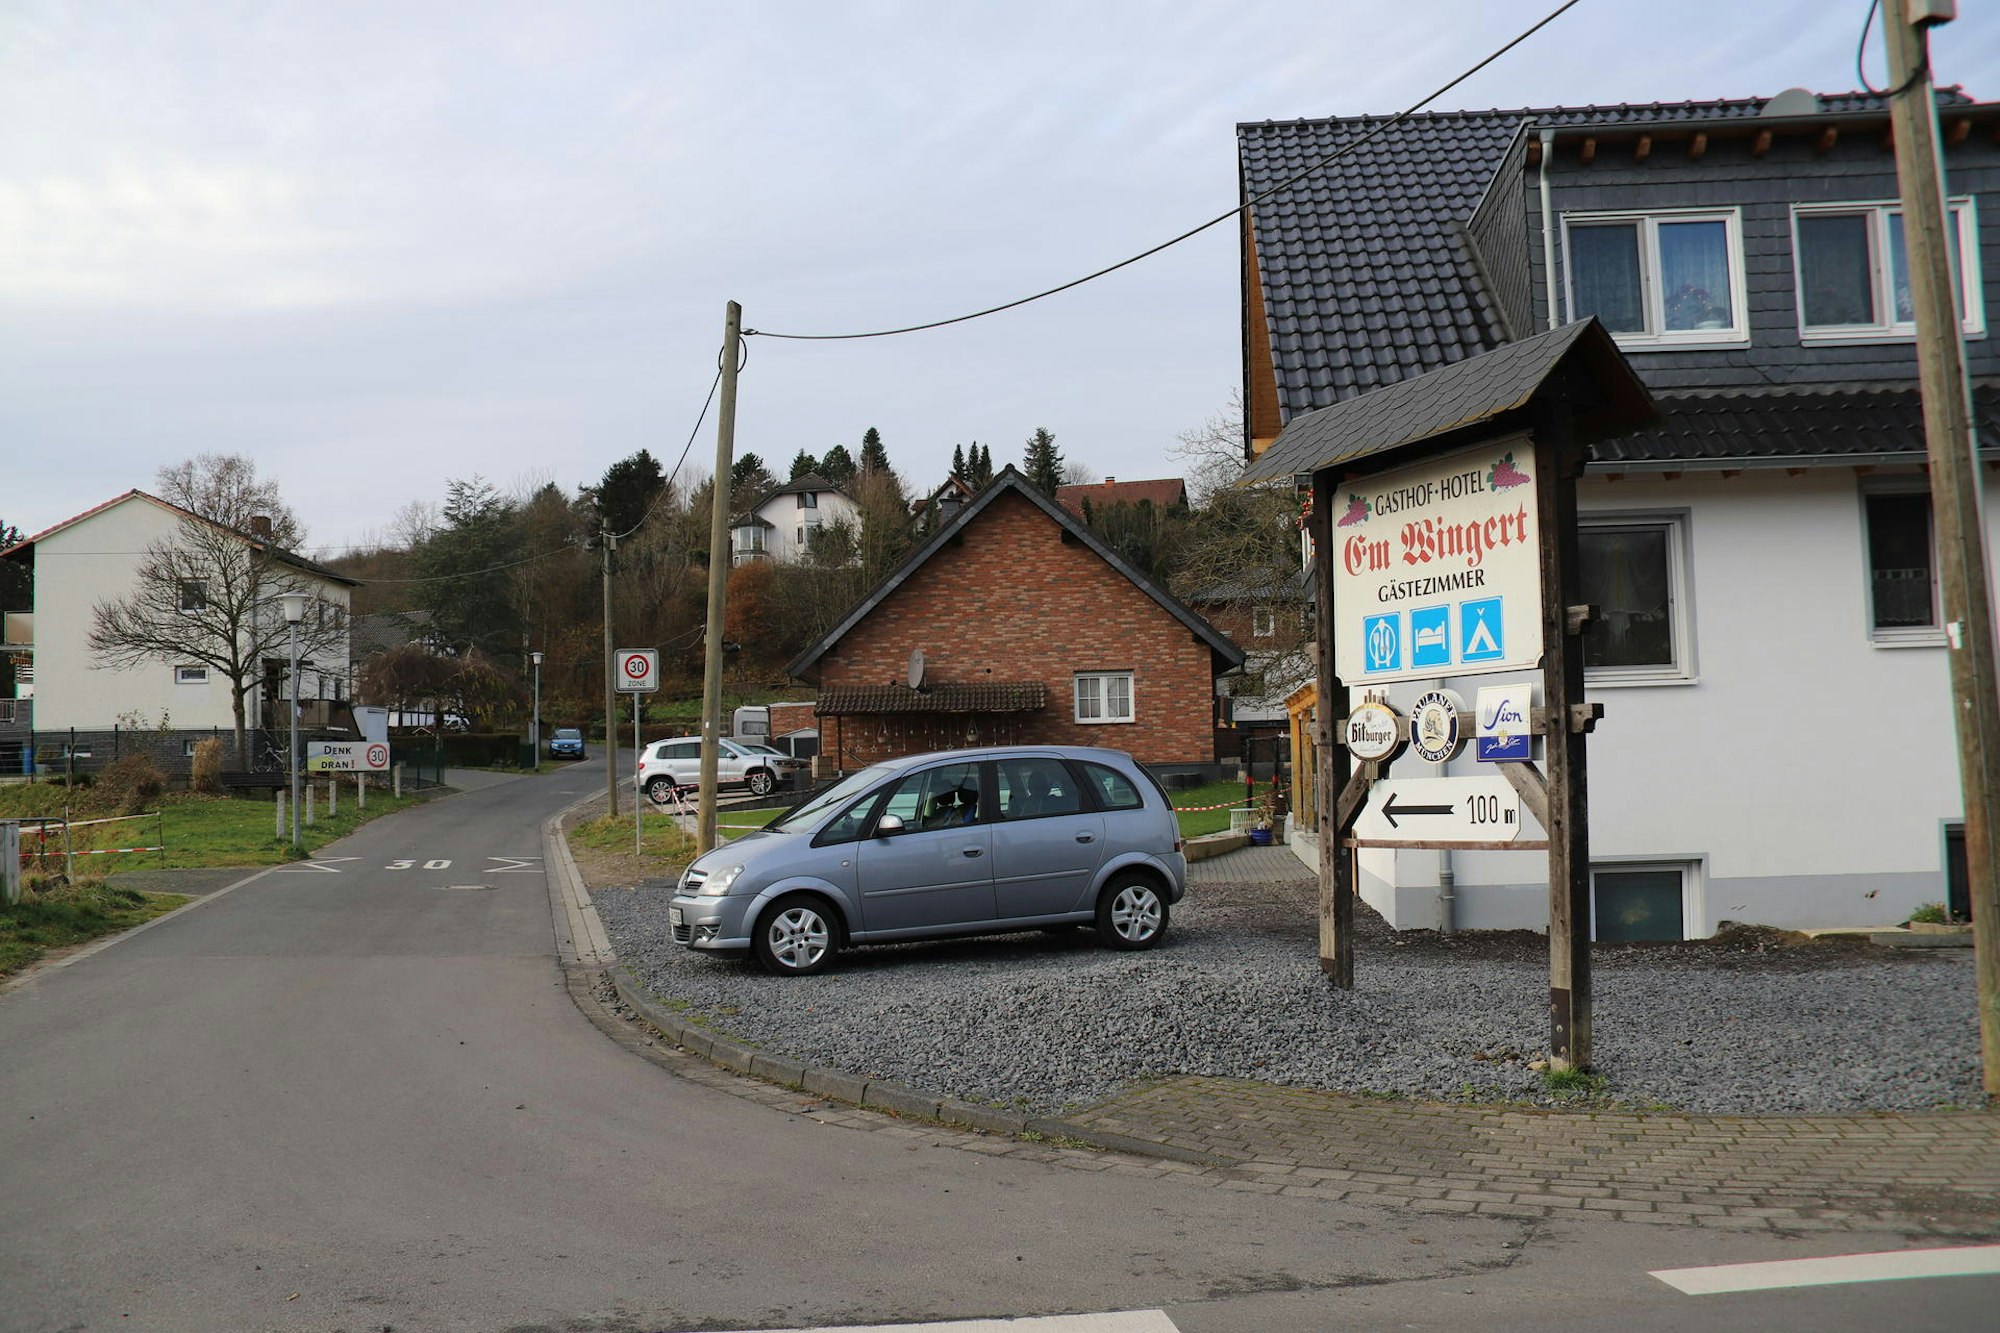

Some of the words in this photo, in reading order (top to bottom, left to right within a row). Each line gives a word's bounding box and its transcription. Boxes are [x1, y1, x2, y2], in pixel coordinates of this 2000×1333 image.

[1344, 534, 1391, 577] Em
[1400, 500, 1528, 568] Wingert
[1378, 568, 1486, 603] GÄSTEZIMMER
[630, 661, 644, 673] 30
[1411, 692, 1456, 722] PAULANER
[1482, 699, 1523, 731] Sion
[1351, 722, 1393, 745] Bitburger
[324, 745, 352, 755] DENK
[371, 750, 384, 762] 30
[1466, 794, 1499, 825] 100
[1504, 808, 1517, 824] m
[384, 859, 453, 870] 30
